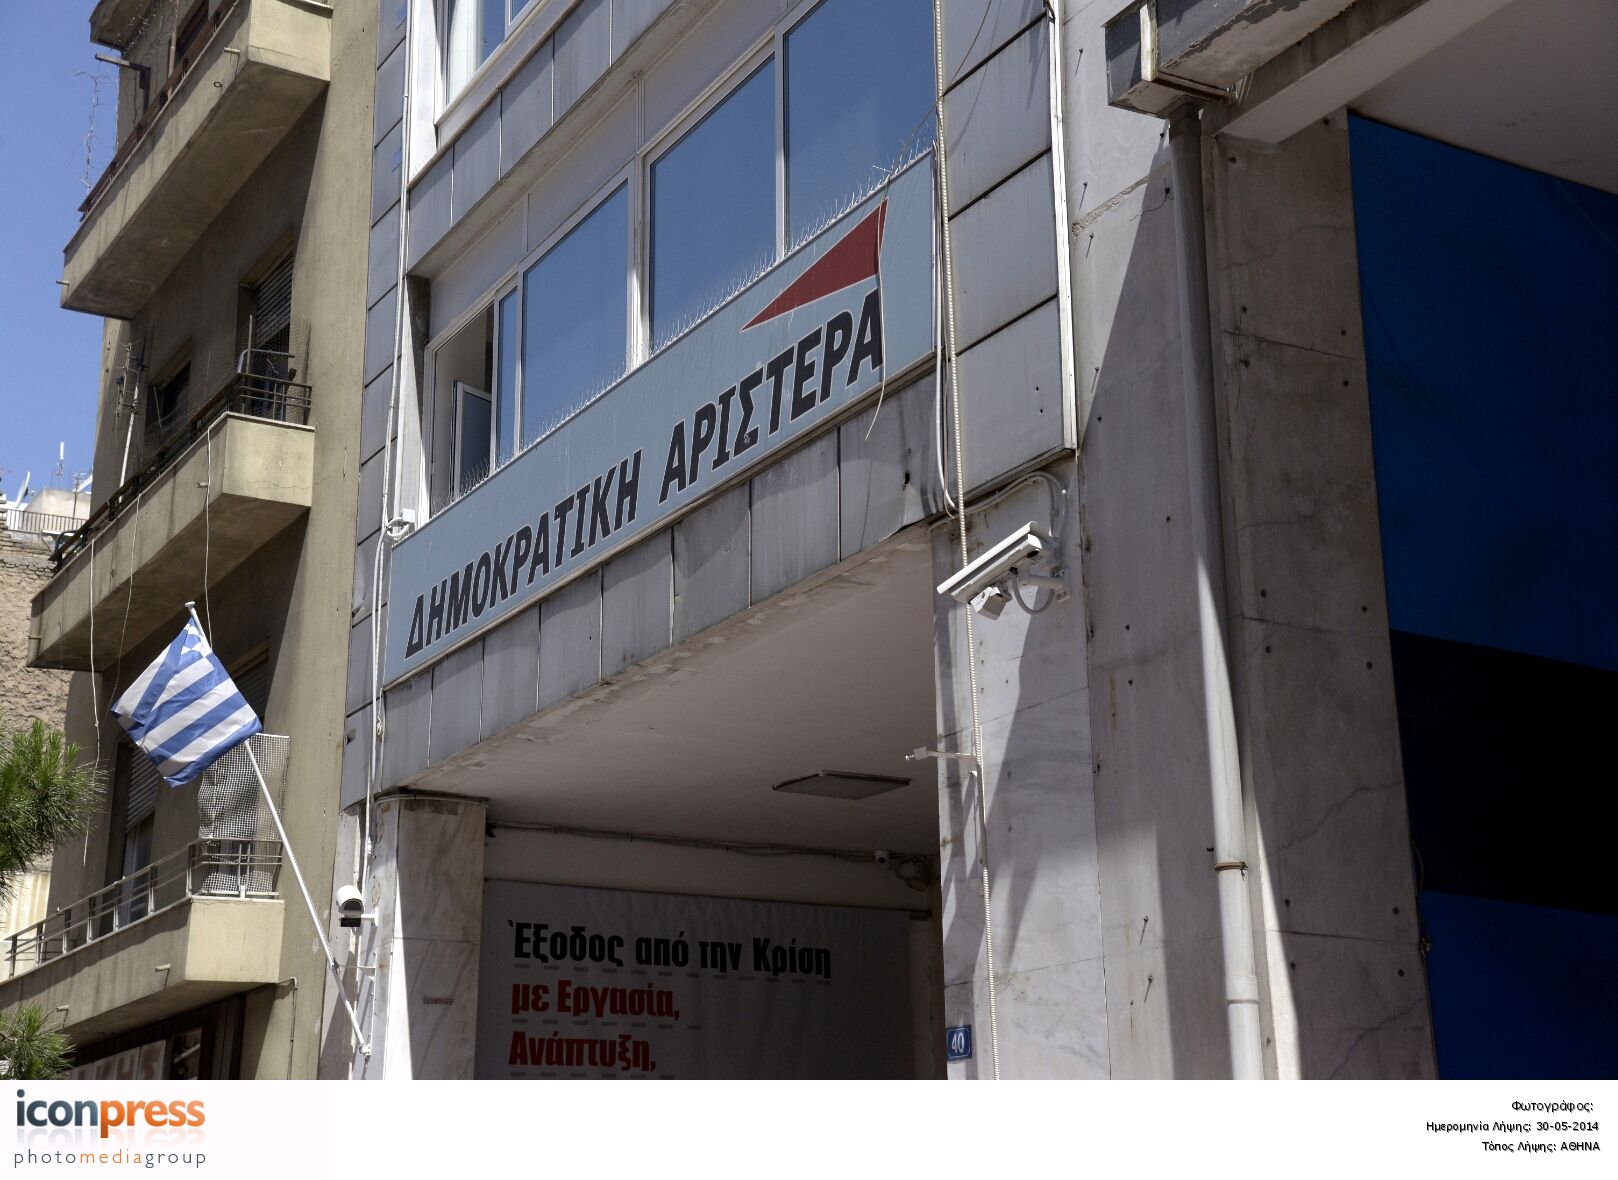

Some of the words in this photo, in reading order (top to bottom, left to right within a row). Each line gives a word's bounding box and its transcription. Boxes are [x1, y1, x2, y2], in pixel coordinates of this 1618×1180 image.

[405, 448, 642, 660] ΔΗΜΟΚΡΑΤΙΚΗ
[658, 288, 884, 505] ΑΡΙΣΤΕΡΑ
[636, 931, 689, 967] από
[699, 940, 742, 973] την
[752, 937, 831, 979] Κρίση
[511, 983, 550, 1015] με
[556, 979, 681, 1022] Εργασία,
[508, 1030, 657, 1072] Ανάπτυξη,
[951, 1031, 965, 1054] 40
